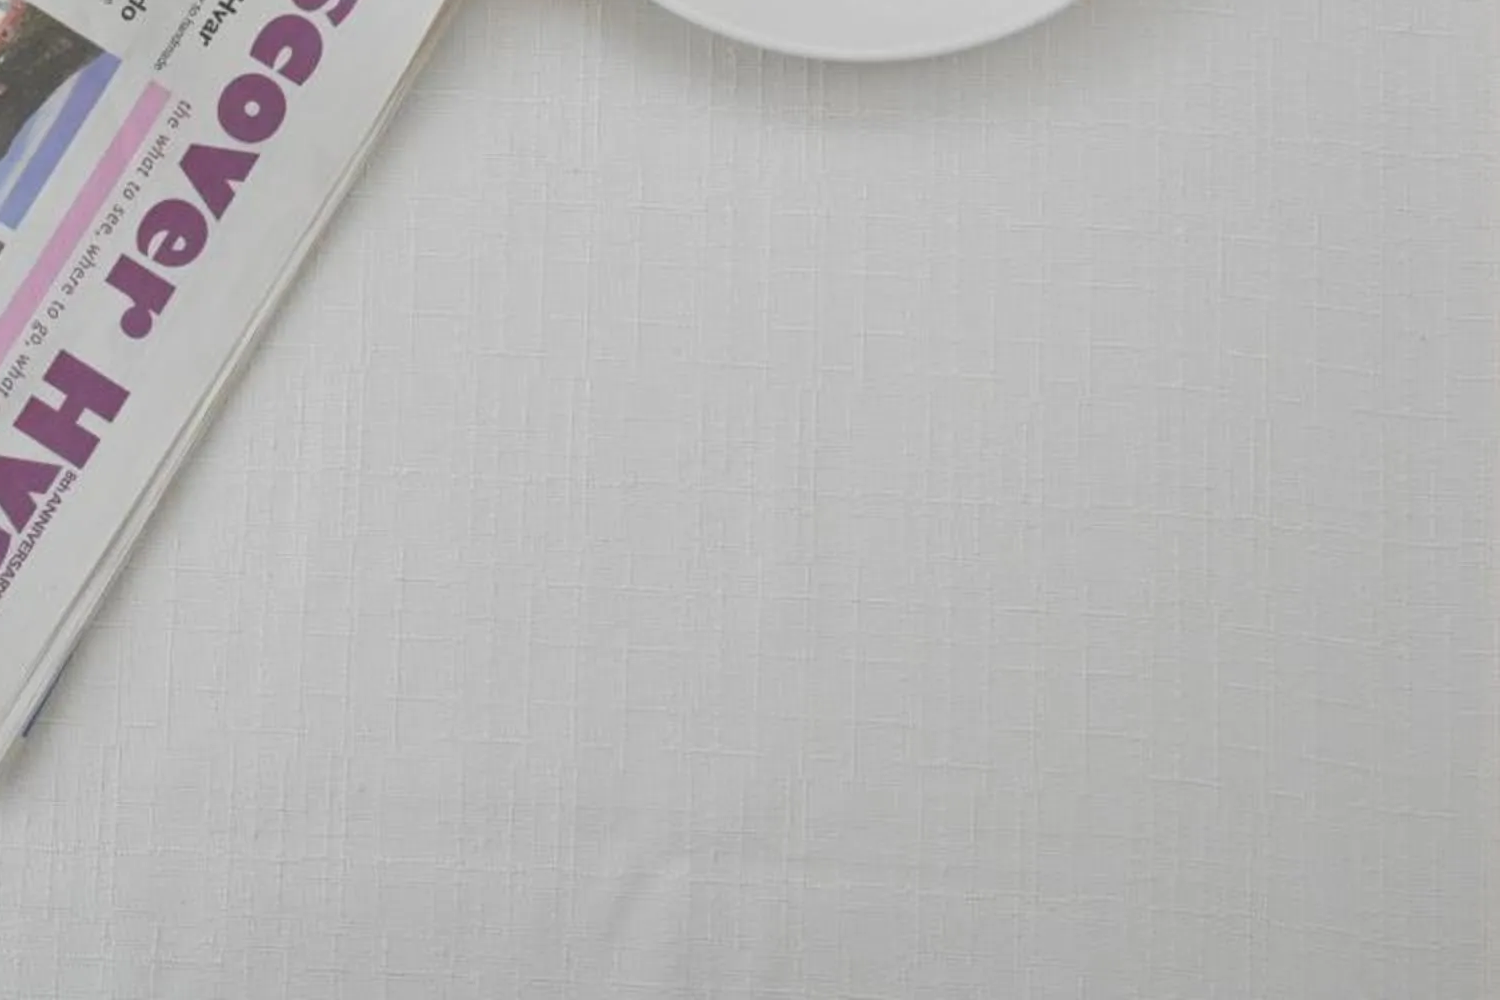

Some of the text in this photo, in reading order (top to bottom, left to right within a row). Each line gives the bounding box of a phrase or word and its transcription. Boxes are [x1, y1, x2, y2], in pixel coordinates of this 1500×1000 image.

[166, 99, 192, 129] the
[136, 134, 171, 178] what
[122, 181, 141, 201] to
[94, 203, 125, 236] see,
[60, 243, 101, 296] where
[46, 300, 66, 320] to
